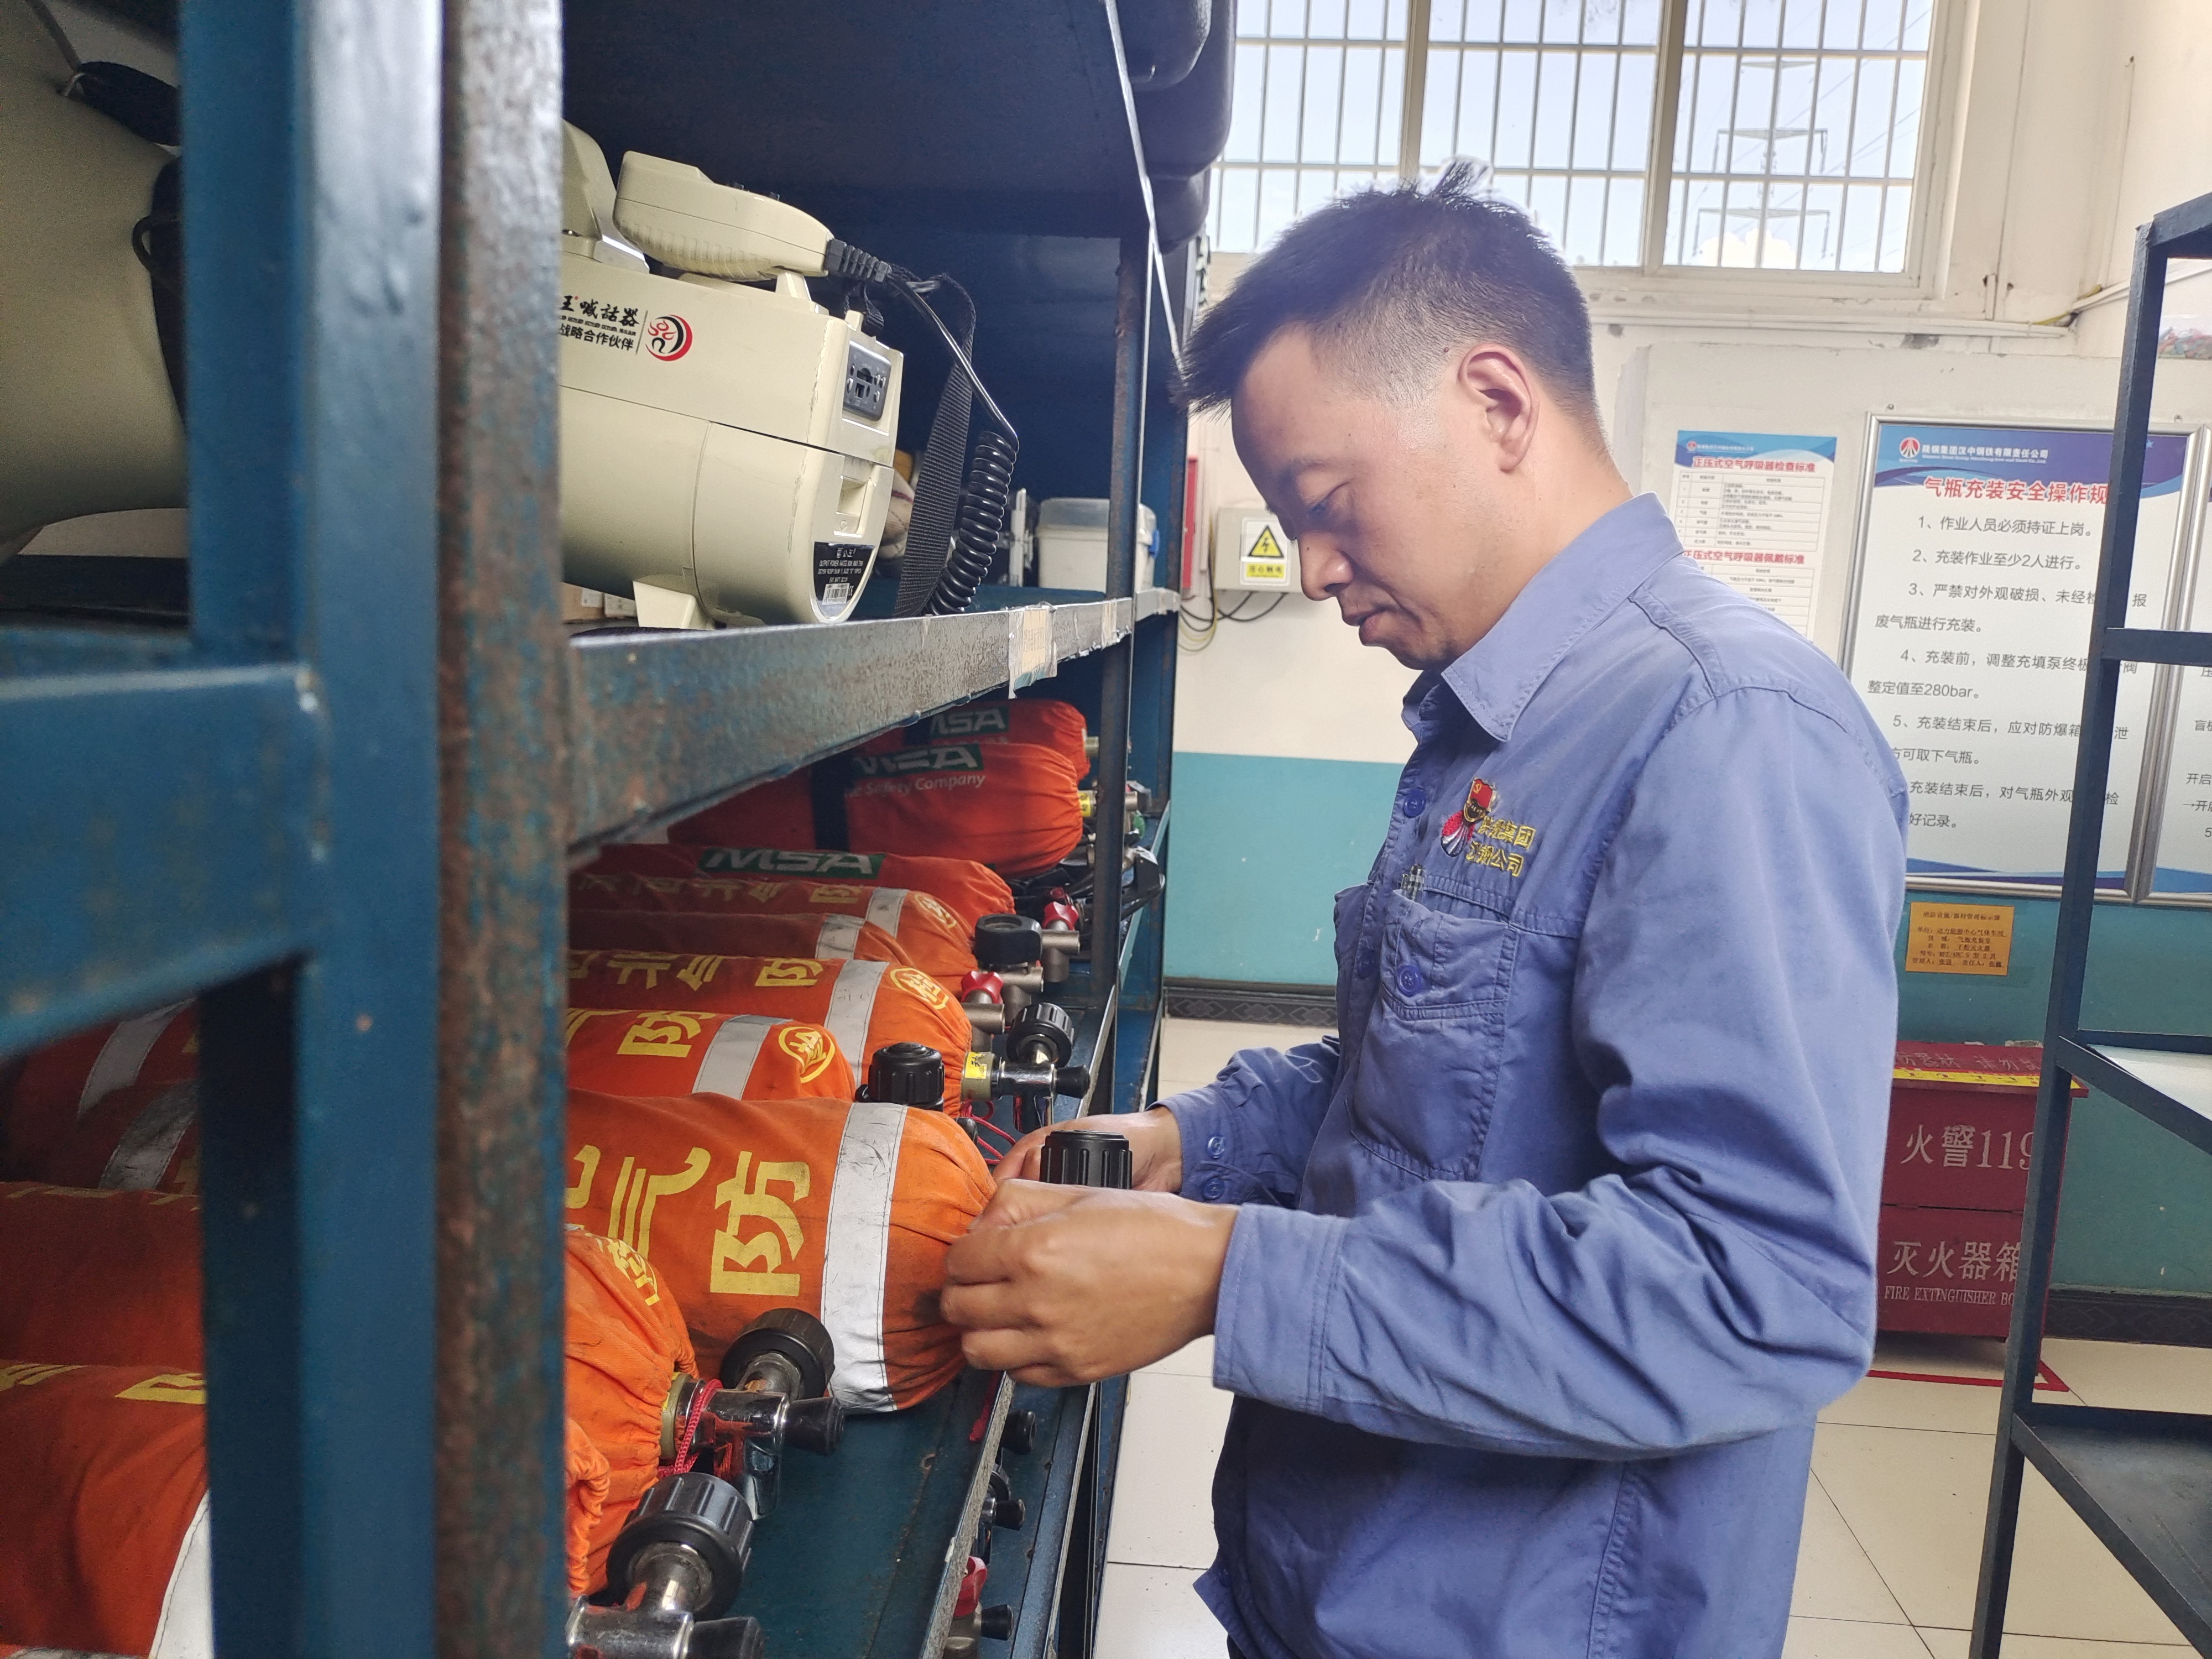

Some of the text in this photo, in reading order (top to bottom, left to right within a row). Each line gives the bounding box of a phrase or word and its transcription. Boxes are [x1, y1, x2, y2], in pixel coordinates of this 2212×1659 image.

[1918, 515, 2091, 537] 1、作业人员必须持证上岗。
[1912, 549, 2081, 570] 2、充装作业至少2人进行。
[1875, 614, 1982, 633] 废气瓶进行充装。
[1867, 680, 1979, 700] 整定值至280bar。
[915, 774, 986, 791] Company
[705, 848, 873, 874] MSA
[1900, 1124, 2034, 1170] 火警119
[1887, 1240, 2021, 1282] 灭火器箱
[1885, 1285, 1910, 1300] FIRE
[1914, 1287, 1996, 1306] EXTINGUISHER
